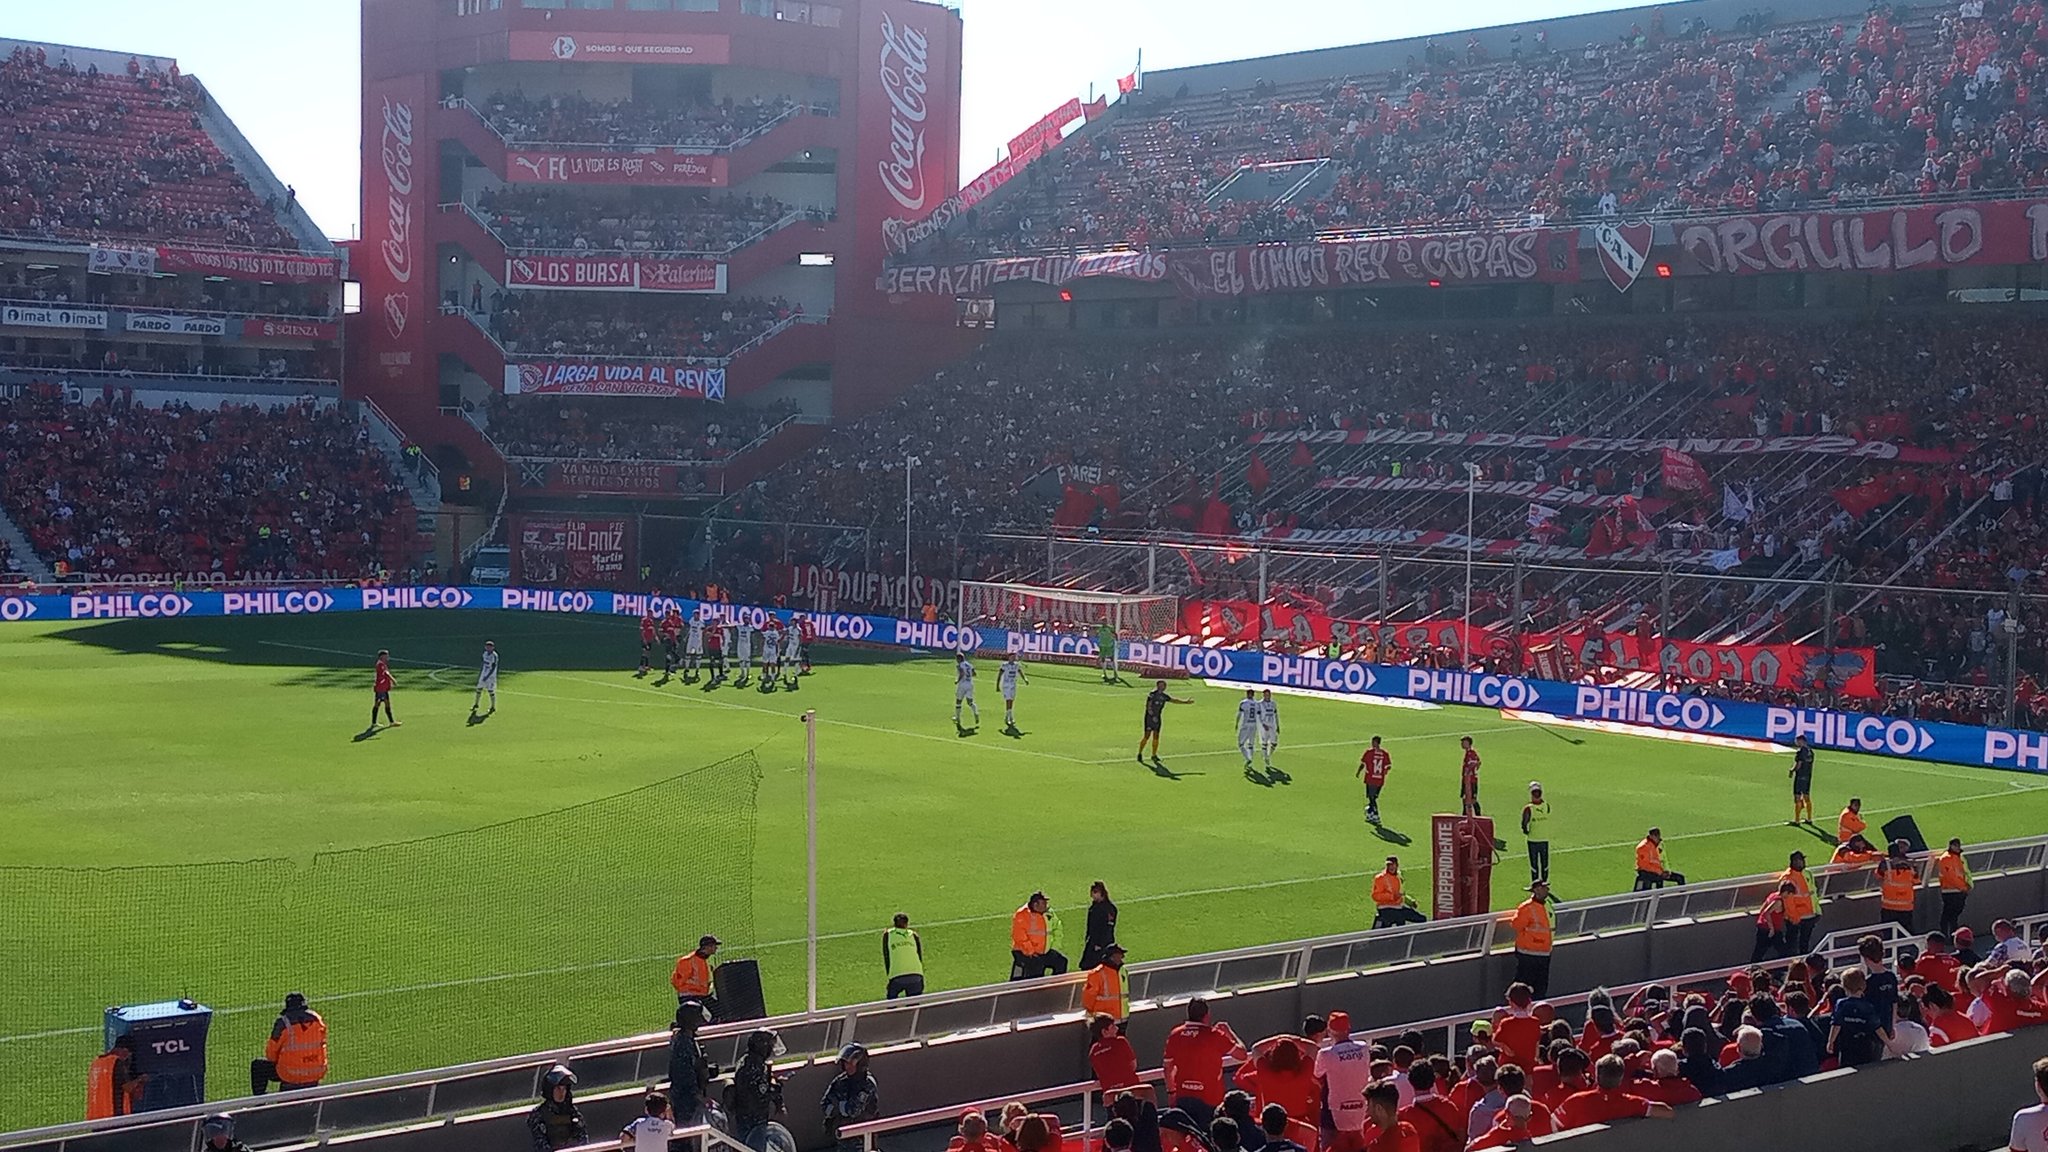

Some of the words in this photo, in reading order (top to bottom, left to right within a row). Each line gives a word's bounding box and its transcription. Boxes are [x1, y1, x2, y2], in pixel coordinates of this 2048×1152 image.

[585, 45, 616, 53] SOMOS
[644, 46, 693, 54] SEGURIDAD
[879, 8, 928, 210] Coca-Cola
[549, 157, 568, 180] FC
[571, 158, 583, 174] LA
[585, 158, 605, 172] VIDA
[607, 158, 620, 171] ES
[1681, 207, 1984, 274] ORGULLO
[191, 252, 221, 267] TODOS
[221, 254, 237, 269] LOS
[275, 260, 285, 275] TE
[538, 262, 570, 282] LOS
[575, 262, 630, 283] BURSA
[1210, 251, 1244, 296] EL
[1335, 242, 1390, 283] REY
[1421, 232, 1539, 279] COPAS
[20, 309, 52, 322] imat
[71, 312, 103, 325] imat
[132, 319, 172, 331] PARDO
[183, 321, 221, 333] PARDO
[276, 325, 319, 337] SCIENZA
[543, 364, 598, 387] LARGA
[604, 366, 643, 381] VIDA
[649, 366, 668, 384] AL
[675, 368, 704, 393] REY
[561, 463, 577, 476] YA
[581, 464, 618, 476] NADA
[567, 531, 624, 551] ALANIZ
[71, 594, 182, 618] PHILCO
[223, 590, 325, 615] PHILCO
[362, 587, 461, 609] PHILCO
[502, 589, 587, 612] PHILCO
[700, 603, 764, 630] PHILCO
[1260, 607, 1314, 642] LA
[896, 622, 976, 651] PHILCO
[1007, 631, 1093, 656] PHILCO
[1129, 642, 1223, 676] PHILCO
[1659, 643, 1781, 686] ROJO
[1262, 655, 1367, 692] PHILCO
[1408, 669, 1526, 707] PHILCO
[1577, 685, 1710, 729] PHILCO
[1766, 707, 1917, 754] PHILCO
[1437, 822, 1454, 913] INDEPENDIENTE
[152, 1038, 190, 1054] TCL
